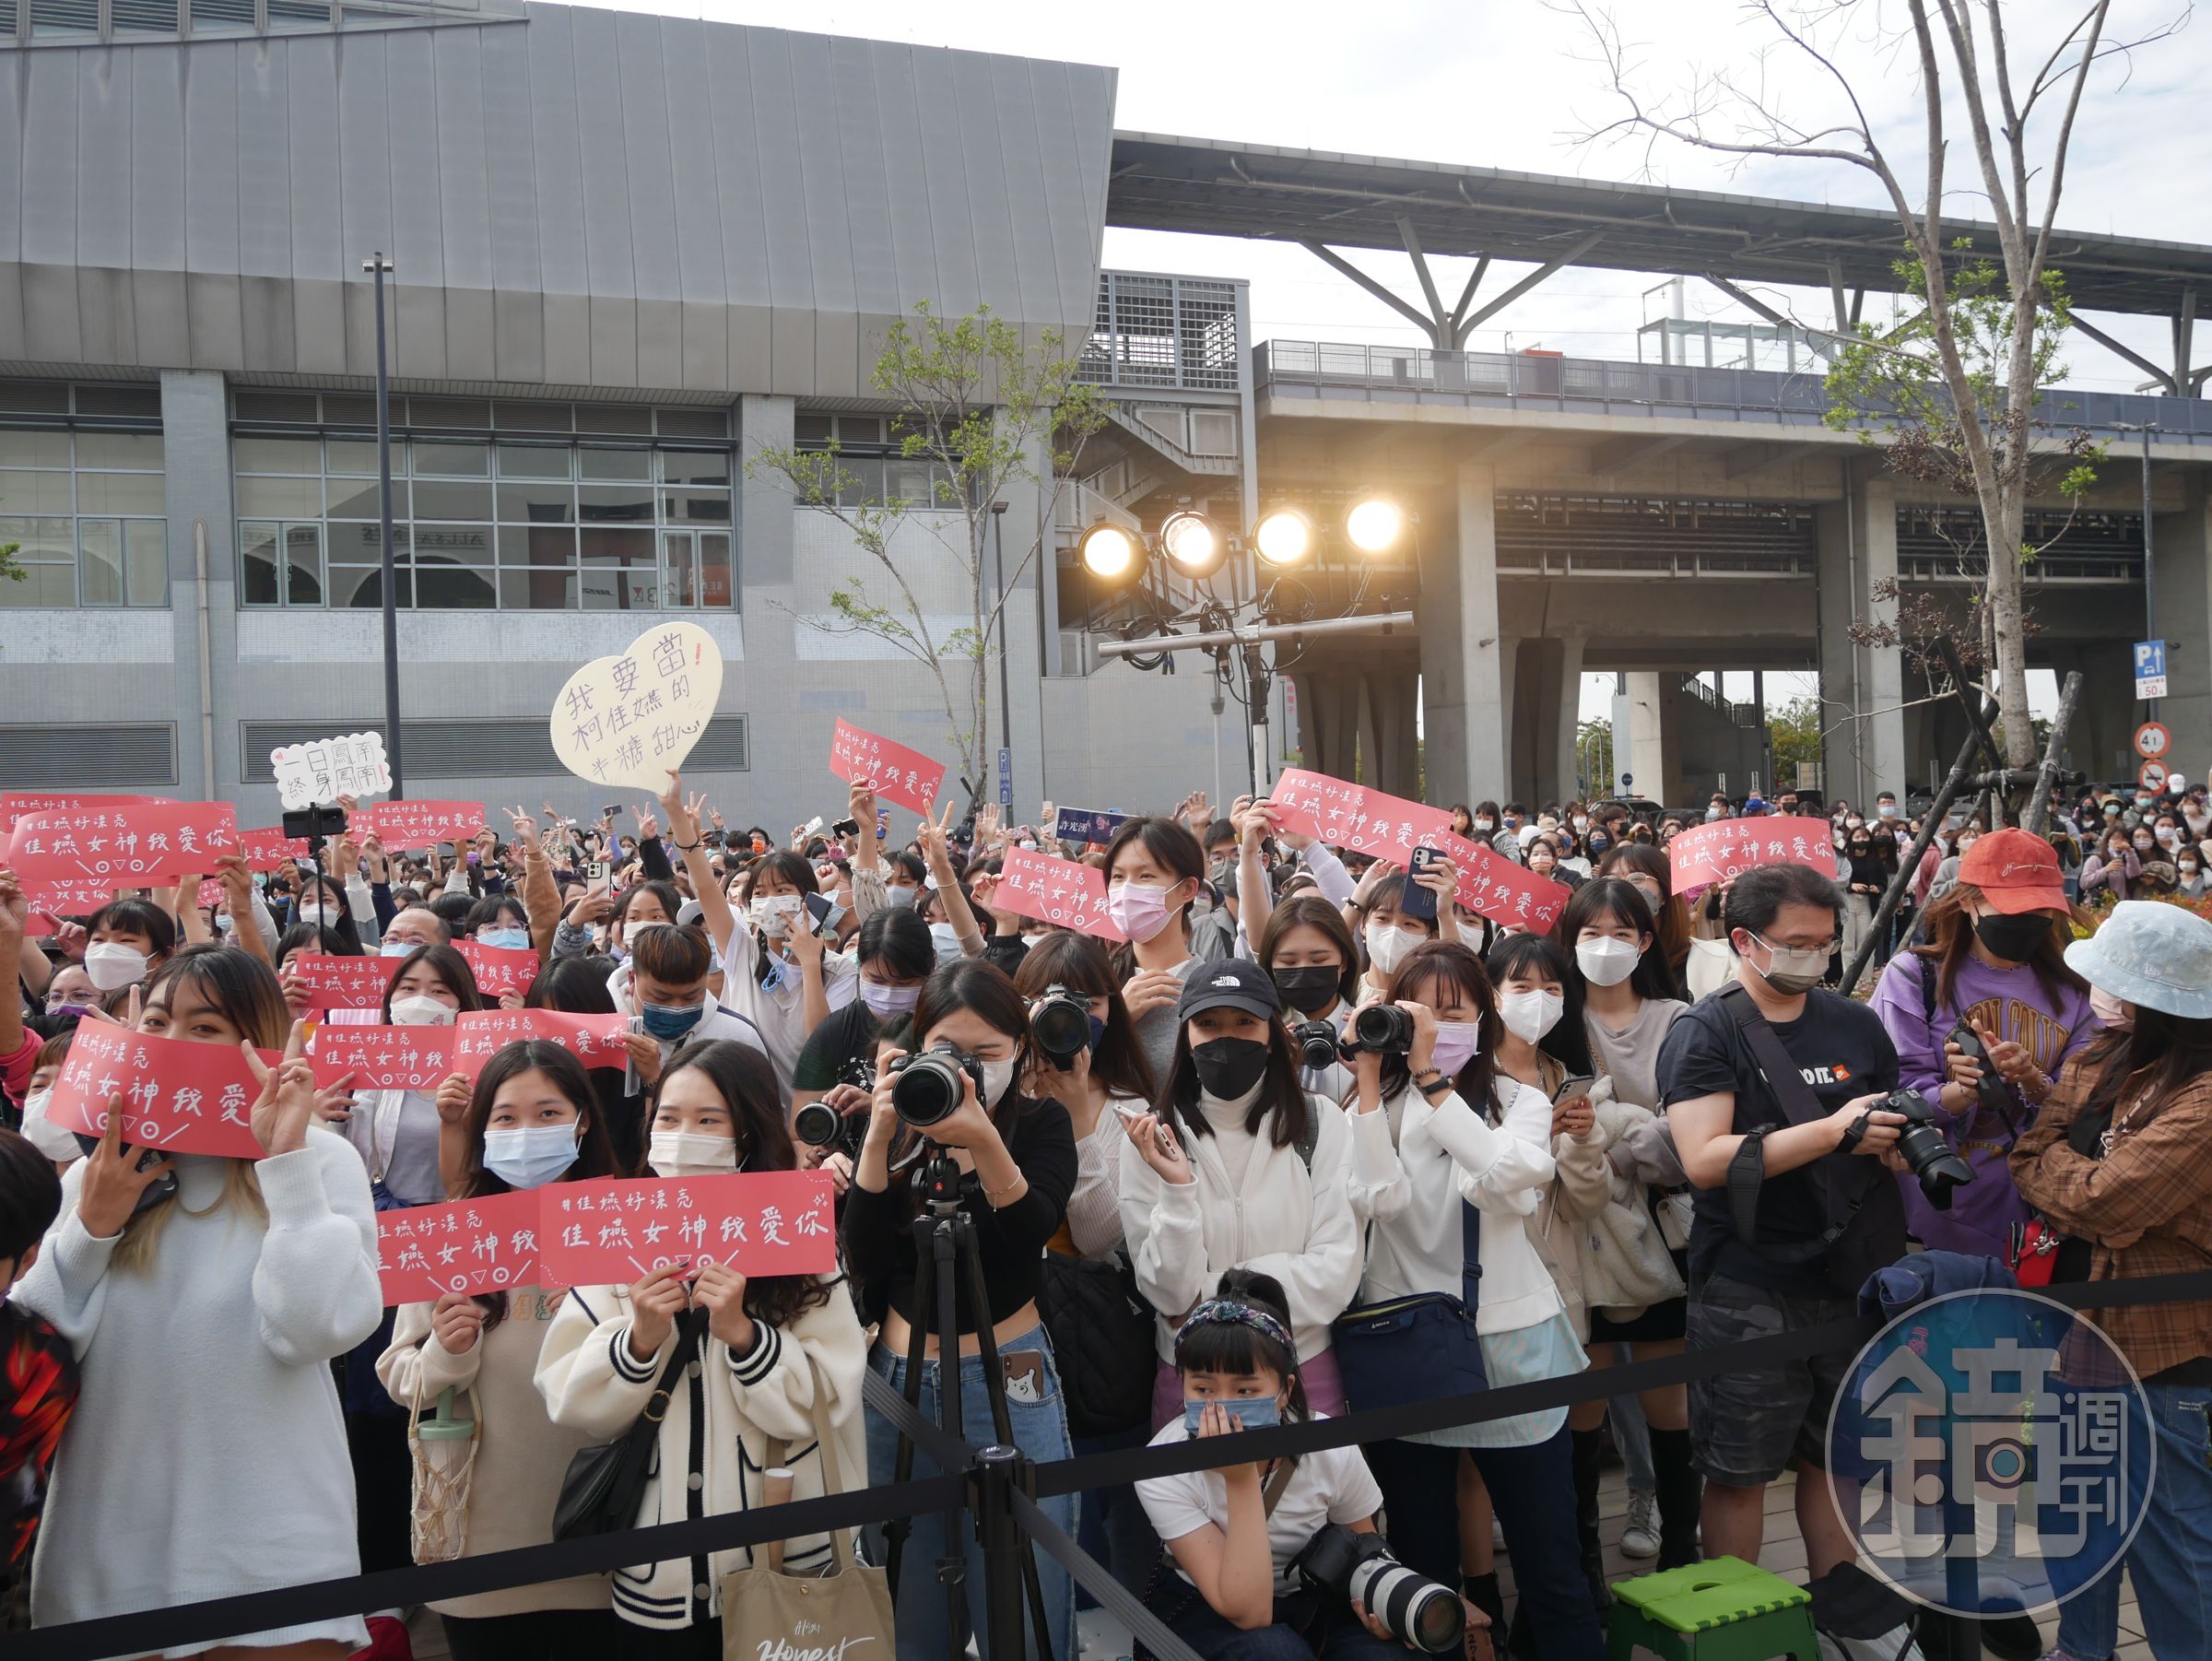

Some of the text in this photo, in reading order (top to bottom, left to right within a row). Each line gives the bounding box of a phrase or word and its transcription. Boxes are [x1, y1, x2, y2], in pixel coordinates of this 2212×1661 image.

[2137, 645, 2152, 667] P
[2146, 685, 2158, 696] 50
[571, 674, 689, 752] 柯佳嬿的
[592, 720, 700, 782] 半糖甜心
[835, 742, 934, 797] 佳嬿女神我愛你
[27, 813, 127, 830] #佳嬿好漂亮
[379, 813, 483, 828] 佳嬿女神我愛你
[25, 826, 232, 855] 佳嬿女神我愛你
[1678, 836, 1831, 869] 佳嬿女神我愛你
[326, 1032, 410, 1046] #佳嬿好漂亮
[561, 1187, 693, 1213] #佳嬿好漂亮
[561, 1206, 830, 1250] 佳嬿女神我愛你
[757, 1636, 875, 1661] Honest
